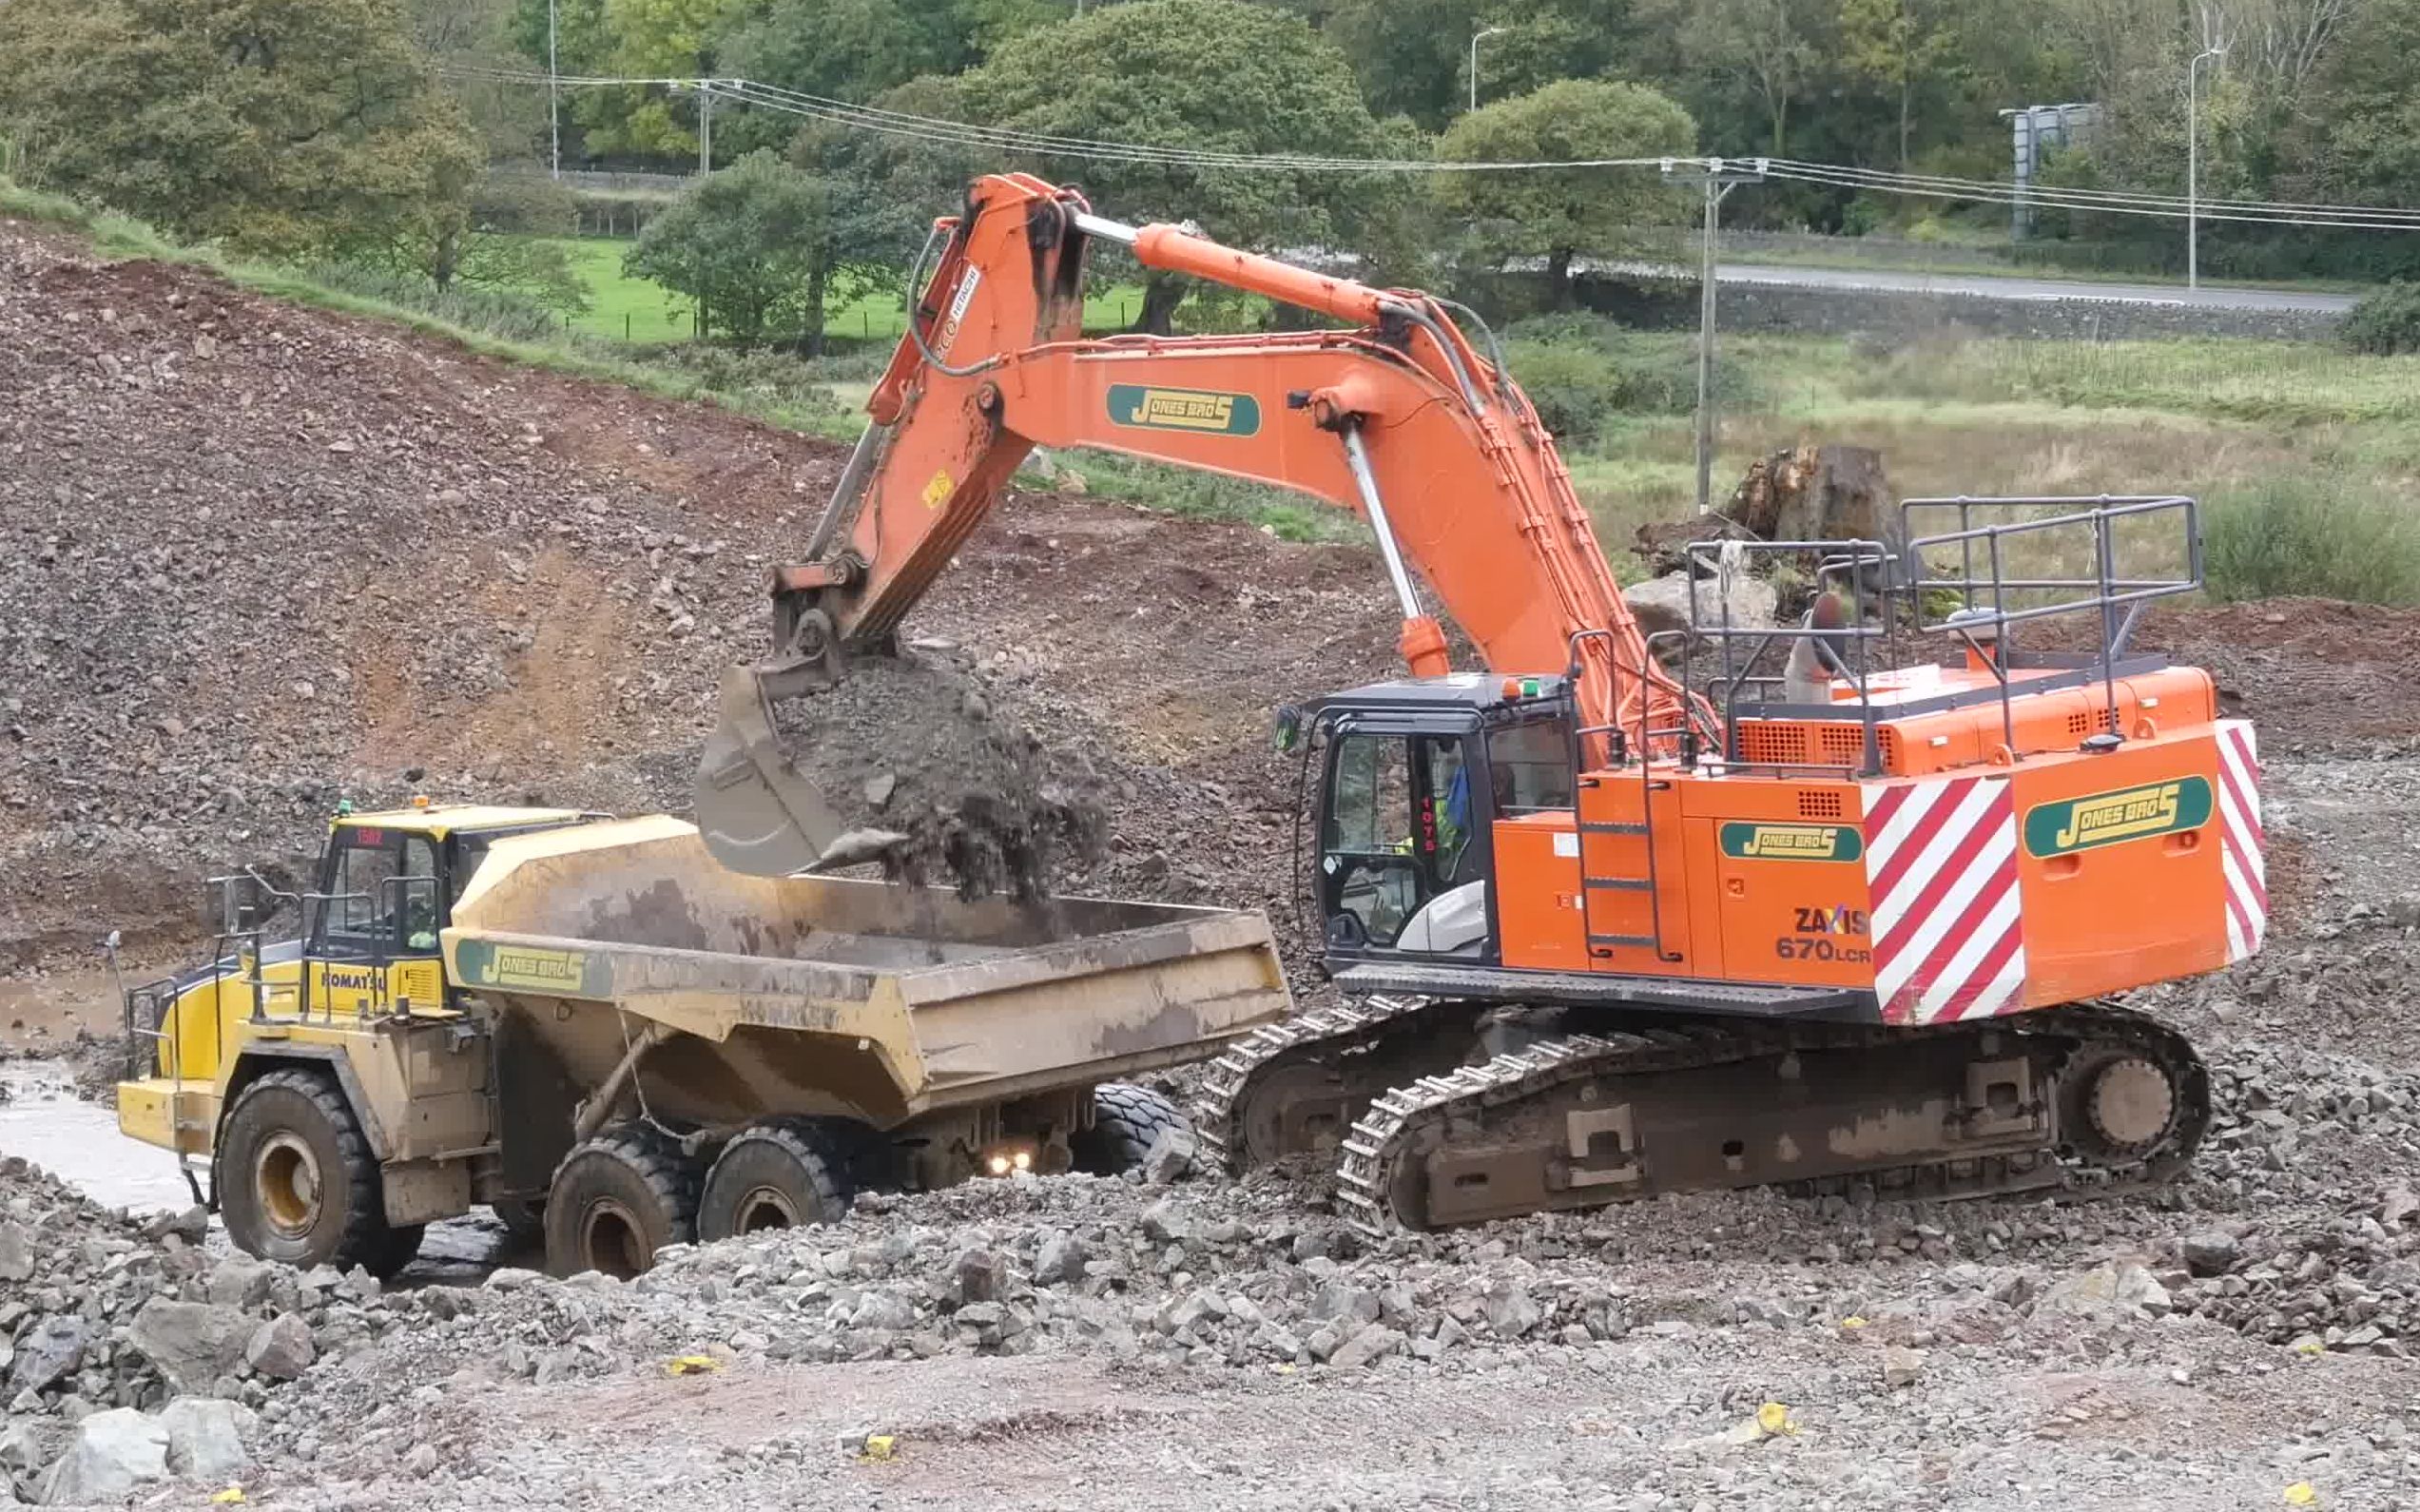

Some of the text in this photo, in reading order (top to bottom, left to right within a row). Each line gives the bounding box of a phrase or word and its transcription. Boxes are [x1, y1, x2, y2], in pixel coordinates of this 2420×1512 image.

[953, 270, 977, 317] HITACHI
[1132, 390, 1233, 430] JONES BROS
[2057, 784, 2180, 848] JONES BROS
[1744, 826, 1837, 858] JONES BROS
[1794, 905, 1869, 936] ZAXIS
[482, 945, 585, 990] JONES BROS
